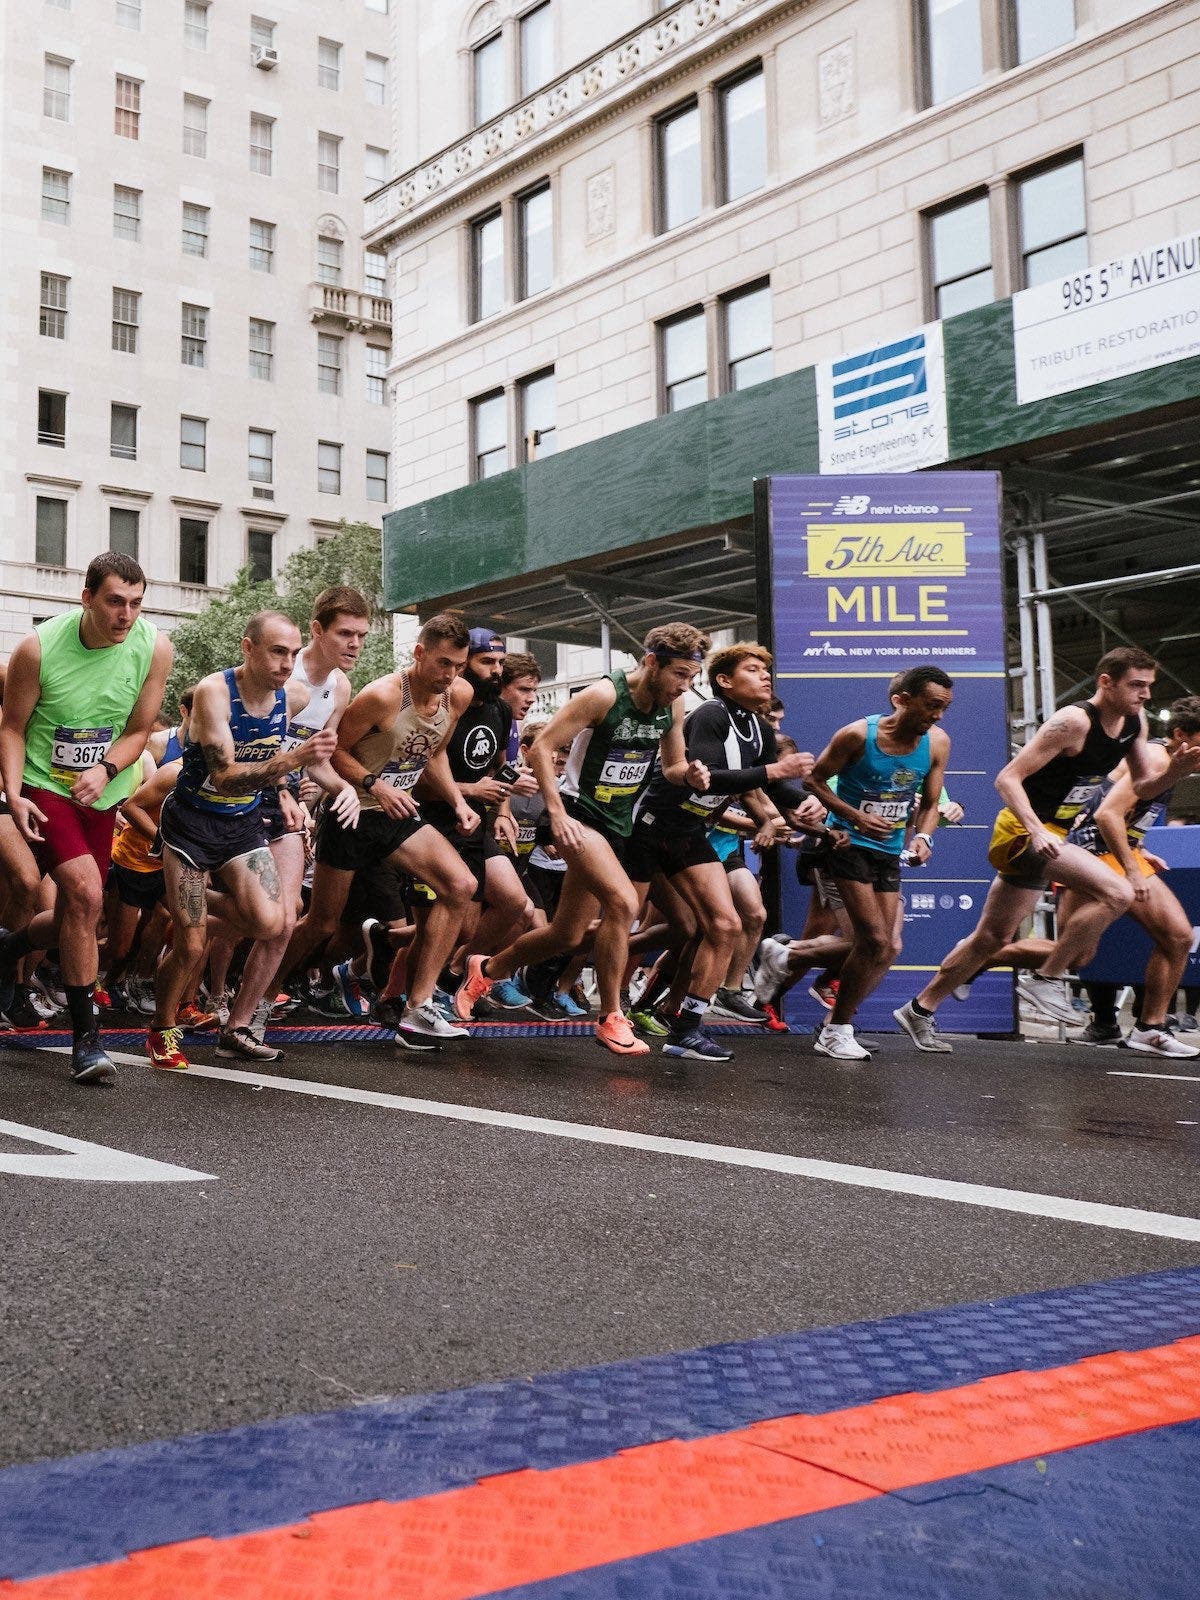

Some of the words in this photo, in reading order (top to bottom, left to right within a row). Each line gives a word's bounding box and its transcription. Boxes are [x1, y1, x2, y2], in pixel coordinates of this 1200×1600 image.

[1062, 274, 1094, 310] 985
[1130, 236, 1200, 288] AVENU
[1030, 342, 1093, 371] TRIBUTE
[830, 450, 857, 466] Stone
[921, 423, 935, 440] PC
[870, 505, 894, 515] new
[894, 504, 939, 515] balance
[825, 536, 884, 571] 5th
[885, 535, 944, 562] Ave.
[827, 585, 949, 622] MILE
[849, 647, 872, 656] NEW
[874, 647, 901, 656] YORK
[902, 647, 930, 656] ROAD
[931, 646, 977, 656] RUNNERS
[56, 744, 65, 759] C
[72, 745, 105, 764] 3673
[606, 765, 615, 777] C
[863, 802, 874, 814] C
